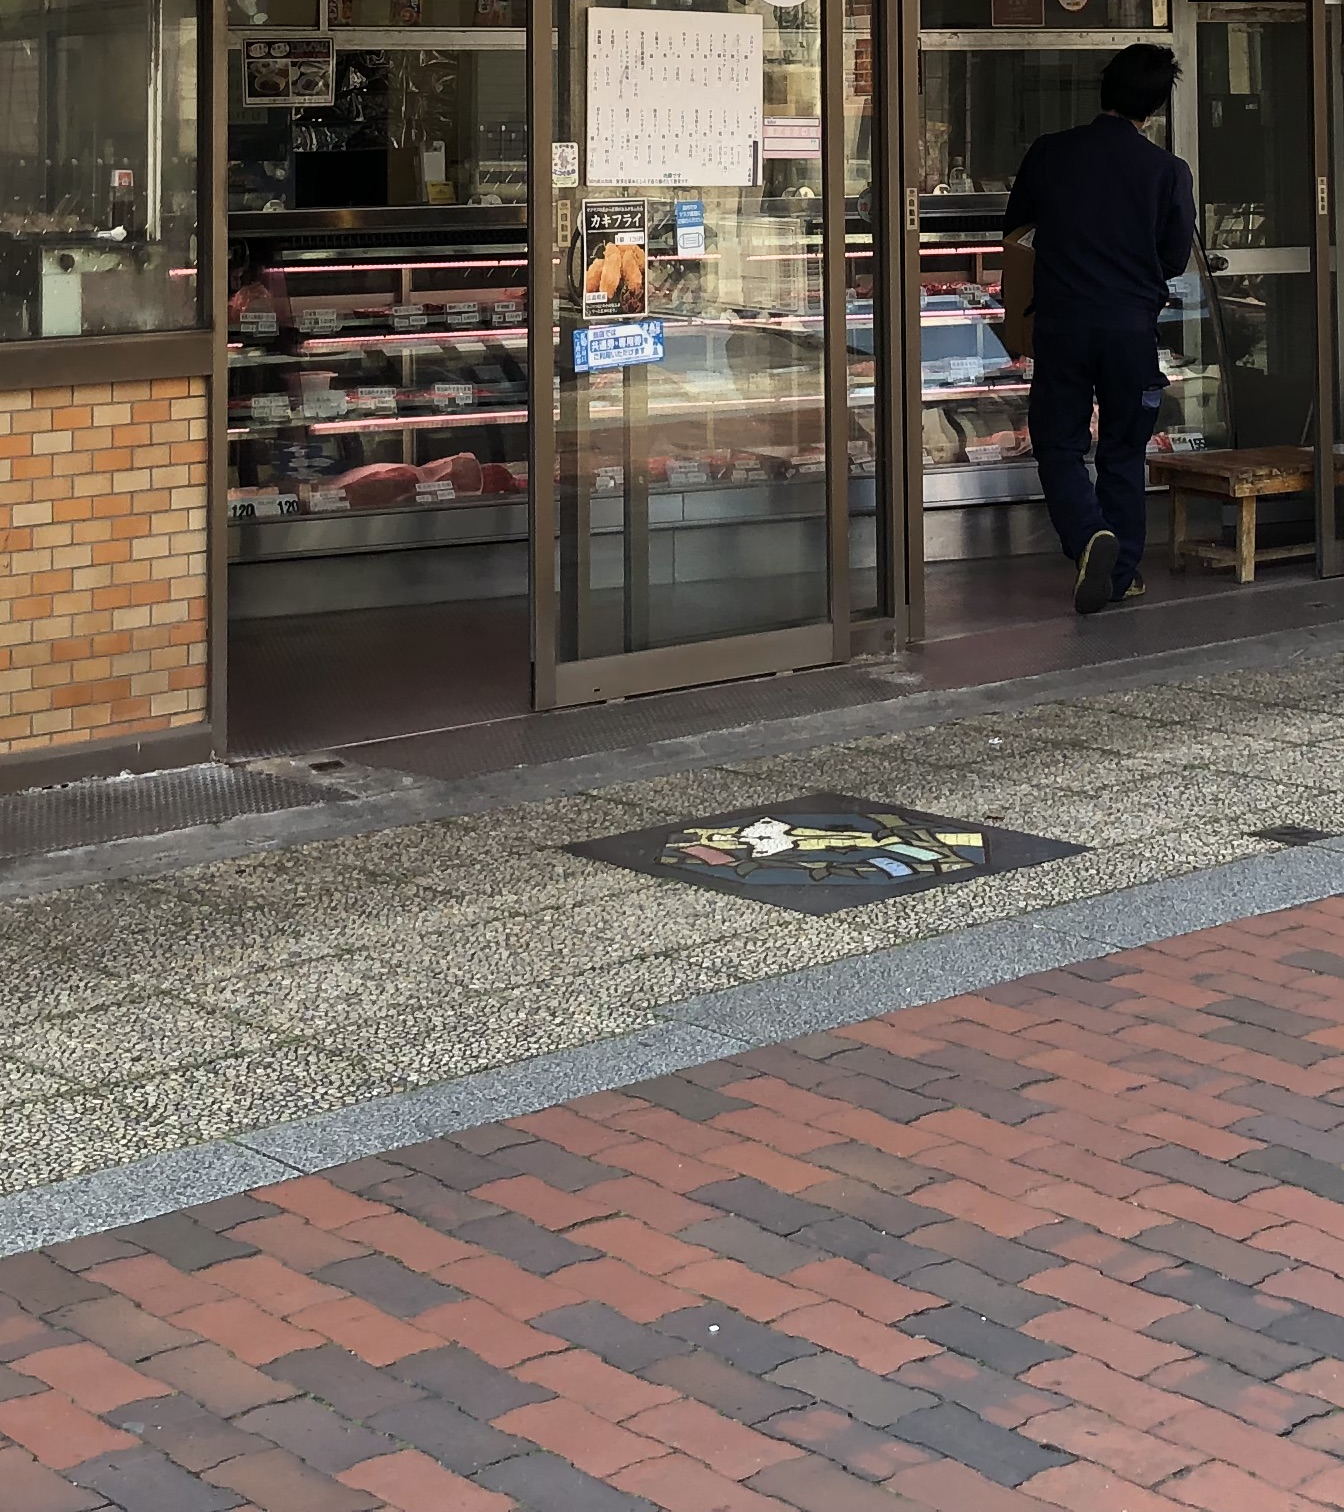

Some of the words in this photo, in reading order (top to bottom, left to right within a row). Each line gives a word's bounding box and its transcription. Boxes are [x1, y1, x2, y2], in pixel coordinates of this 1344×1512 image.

[590, 212, 642, 229] カキフライ
